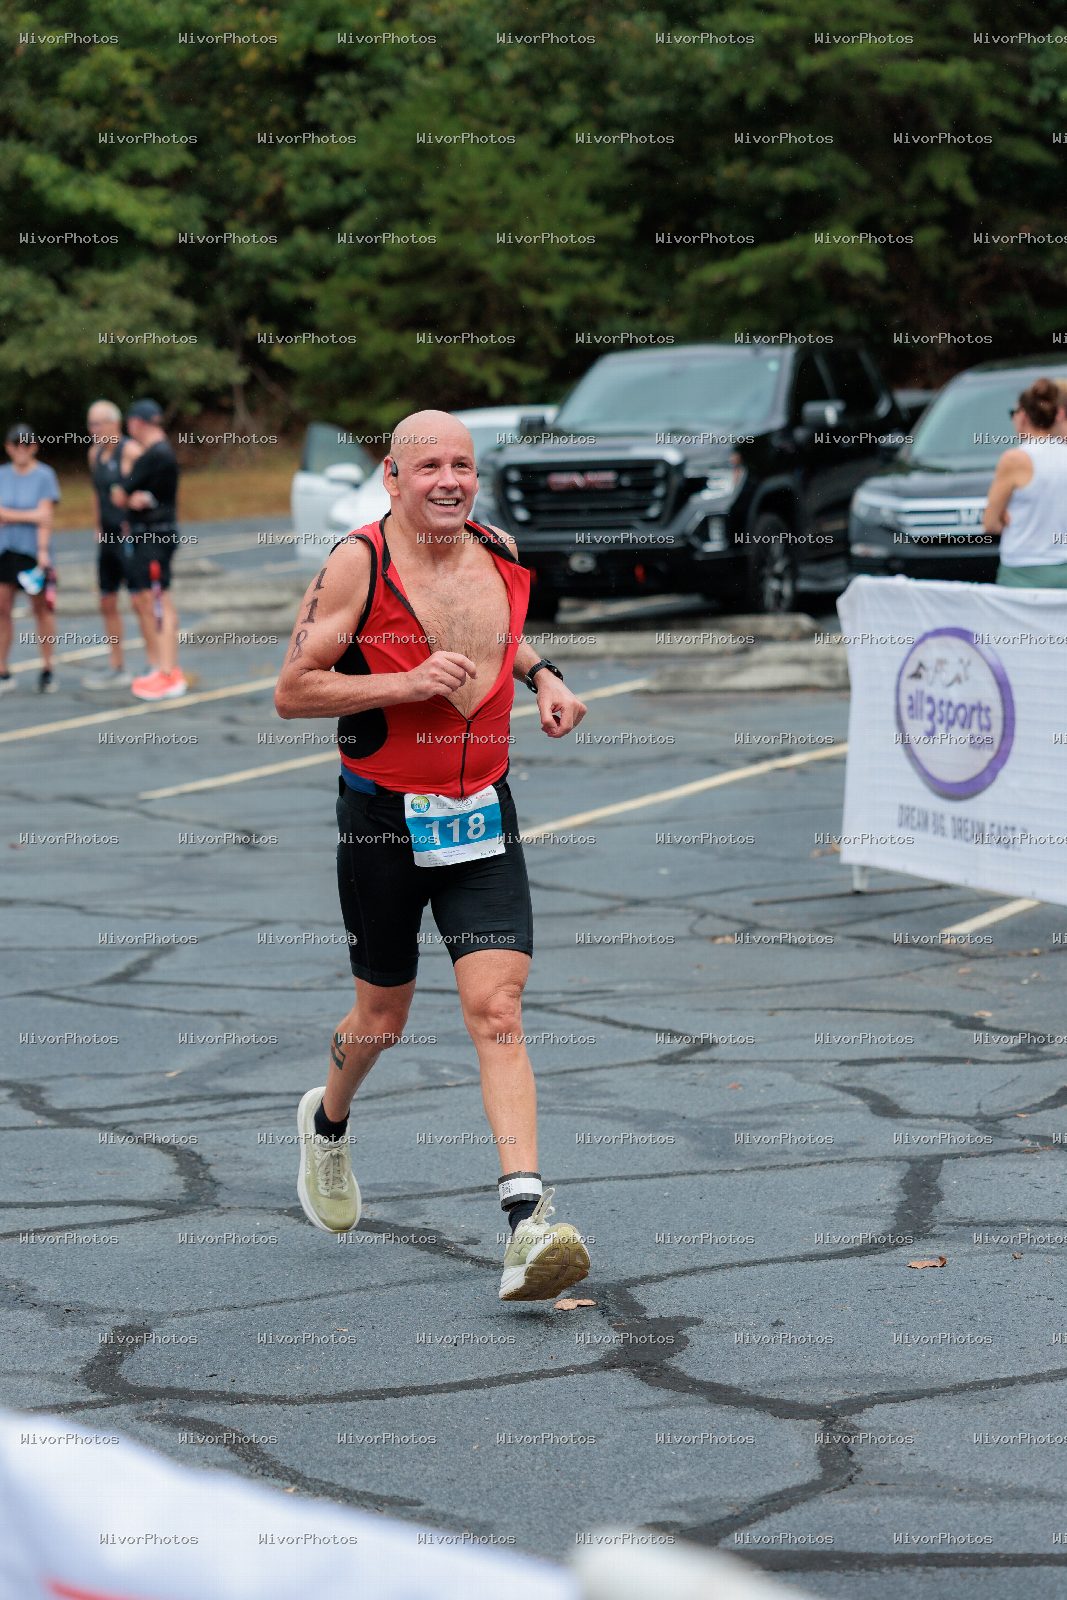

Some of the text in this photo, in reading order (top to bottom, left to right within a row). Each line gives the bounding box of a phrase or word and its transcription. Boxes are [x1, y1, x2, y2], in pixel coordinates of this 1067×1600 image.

[907, 689, 992, 737] all3sports
[425, 812, 487, 846] 118
[897, 803, 929, 834] DREAM
